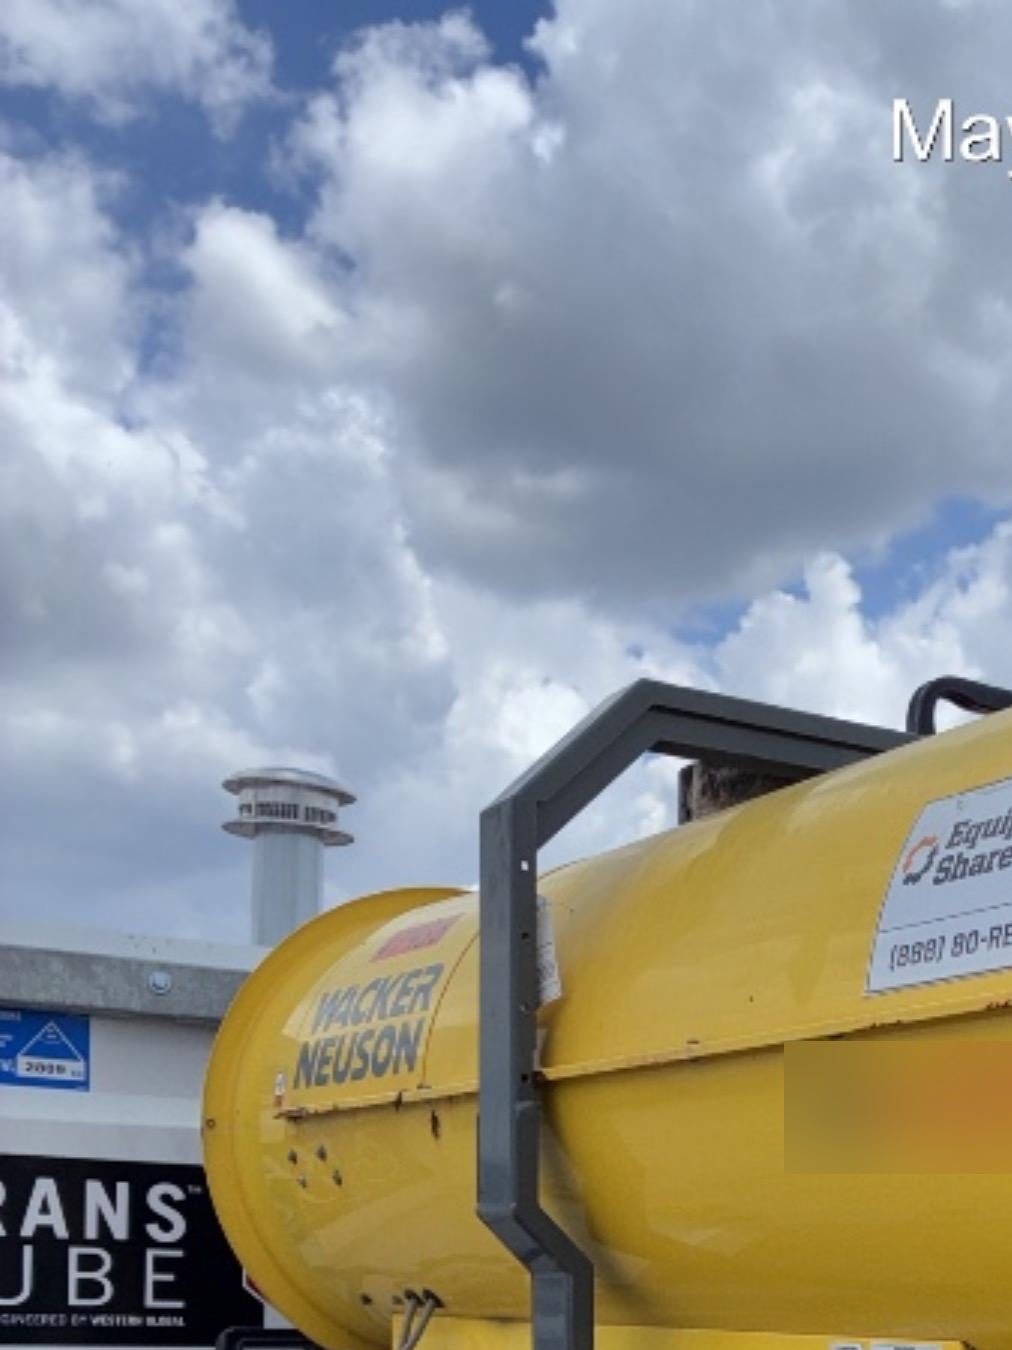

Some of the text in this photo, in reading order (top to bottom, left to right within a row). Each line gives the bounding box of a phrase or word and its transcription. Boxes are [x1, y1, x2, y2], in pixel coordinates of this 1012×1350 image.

[311, 961, 446, 1035] WACKER
[293, 1017, 427, 1090] NEUSON
[0, 1175, 187, 1244] ANS
